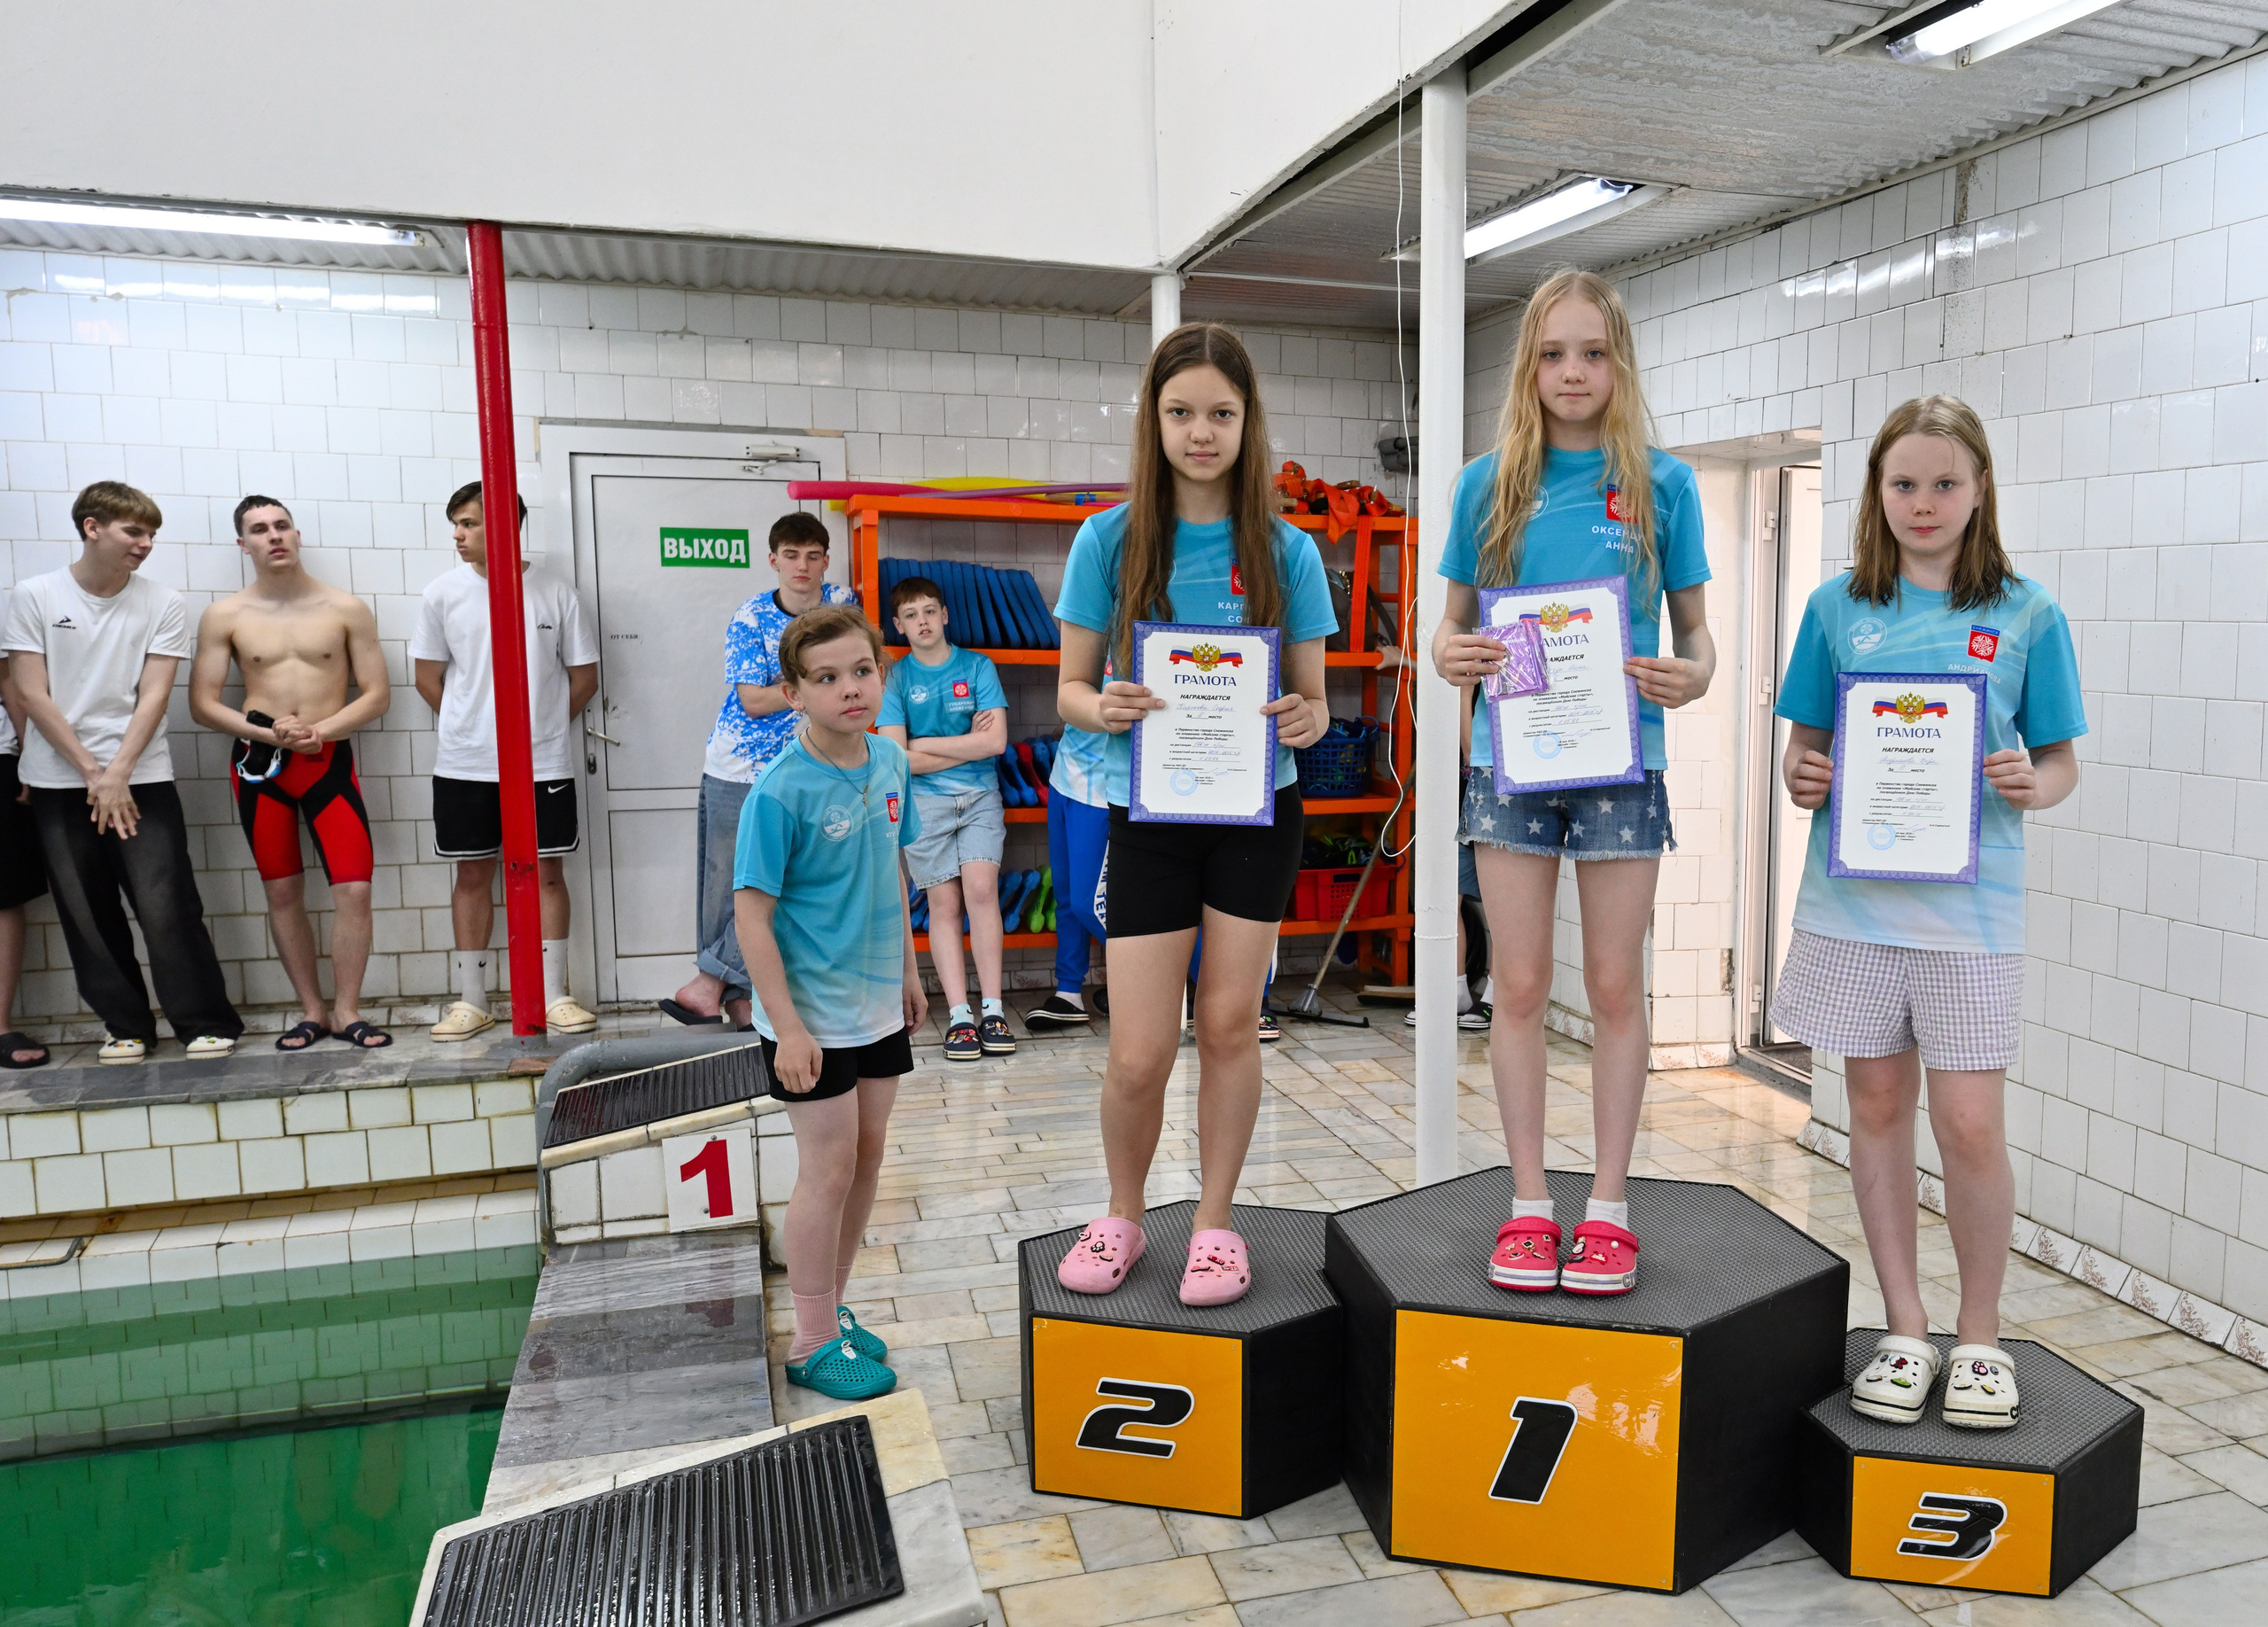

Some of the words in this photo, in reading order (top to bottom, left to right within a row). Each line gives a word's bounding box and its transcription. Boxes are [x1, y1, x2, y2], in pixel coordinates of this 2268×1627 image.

[664, 537, 746, 564] ВЫХОД
[1542, 634, 1589, 648] АМОТА
[1174, 674, 1237, 686] ГРАМОТА
[1876, 727, 1941, 738] ГРАМОТА
[680, 1139, 734, 1218] 1
[1076, 1377, 1195, 1459] 2
[1488, 1396, 1579, 1505] 1
[1896, 1491, 2008, 1561] 3
